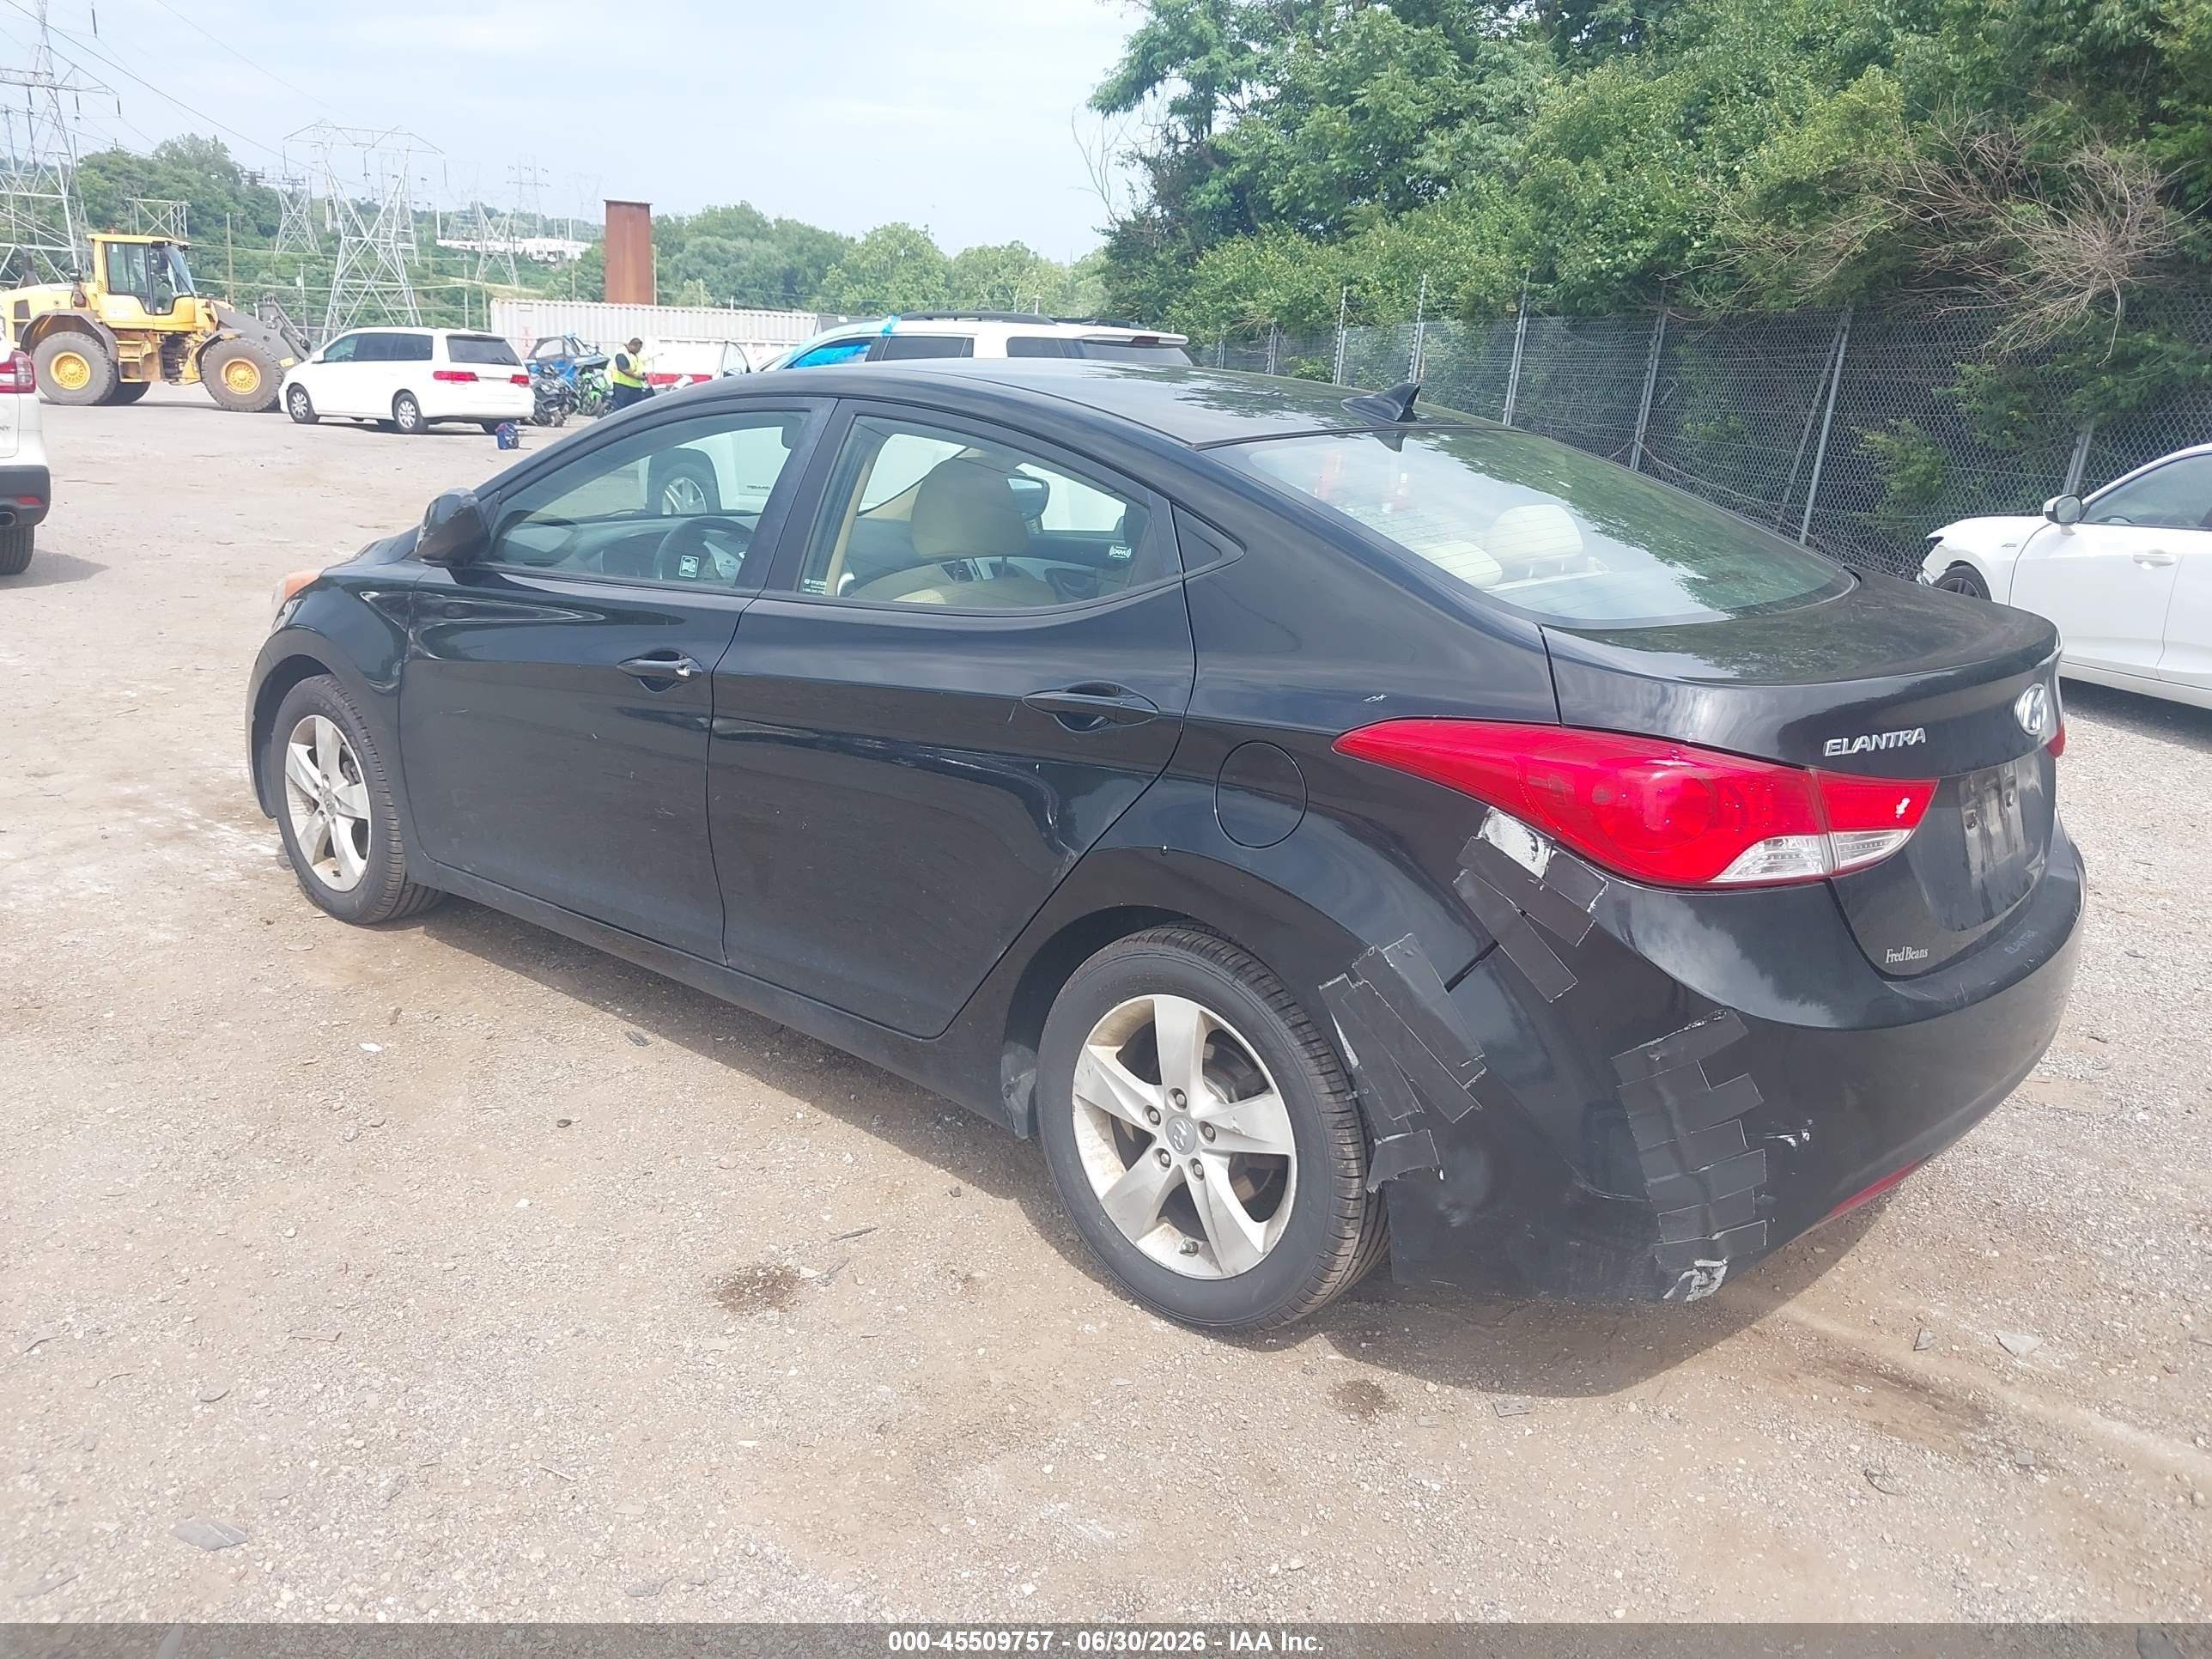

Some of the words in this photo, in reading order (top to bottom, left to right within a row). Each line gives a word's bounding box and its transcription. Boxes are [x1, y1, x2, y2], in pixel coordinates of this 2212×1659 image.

[1823, 727, 1926, 757] ELANTRA
[1885, 945, 1905, 963] Fred
[1905, 946, 1929, 961] Beans
